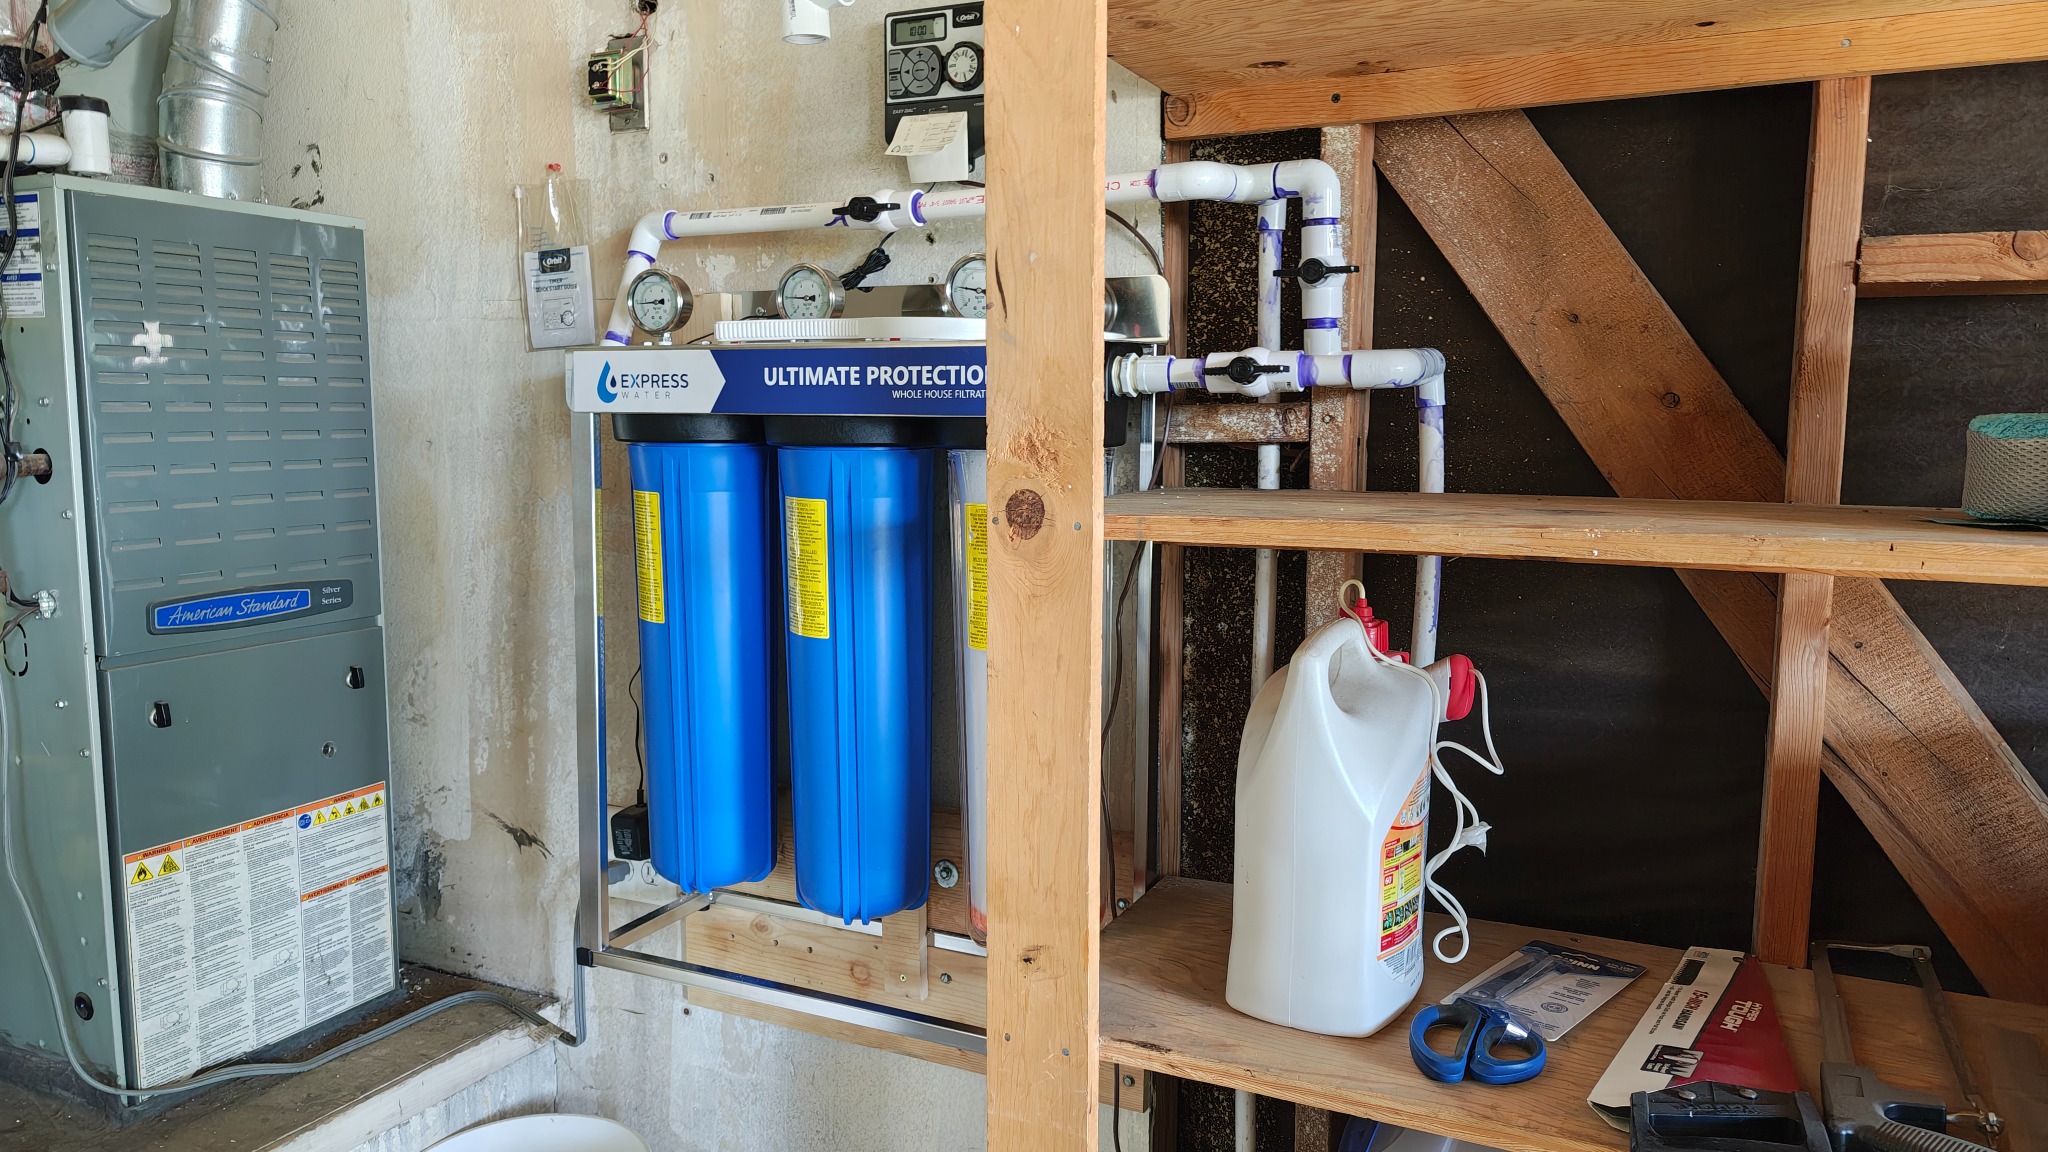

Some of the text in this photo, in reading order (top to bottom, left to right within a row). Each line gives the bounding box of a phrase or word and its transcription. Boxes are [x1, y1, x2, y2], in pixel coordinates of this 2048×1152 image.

[546, 256, 563, 266] Orbit
[621, 373, 689, 389] EXPRESS
[763, 365, 987, 387] ULTIMATE PROTECTIO
[621, 391, 671, 400] WATER
[892, 389, 923, 399] WHOLE
[924, 389, 953, 399] HOUSE
[321, 586, 342, 595] Silver
[321, 596, 342, 605] Series
[168, 592, 300, 626] American Standard
[333, 792, 355, 804] WARNING
[253, 812, 290, 827] ADVERTENCIA
[191, 826, 238, 845] AVERTISSEMENT
[142, 845, 171, 859] WARNING
[1720, 999, 1754, 1034] TOUGH
[1745, 1001, 1764, 1022] HYPER
